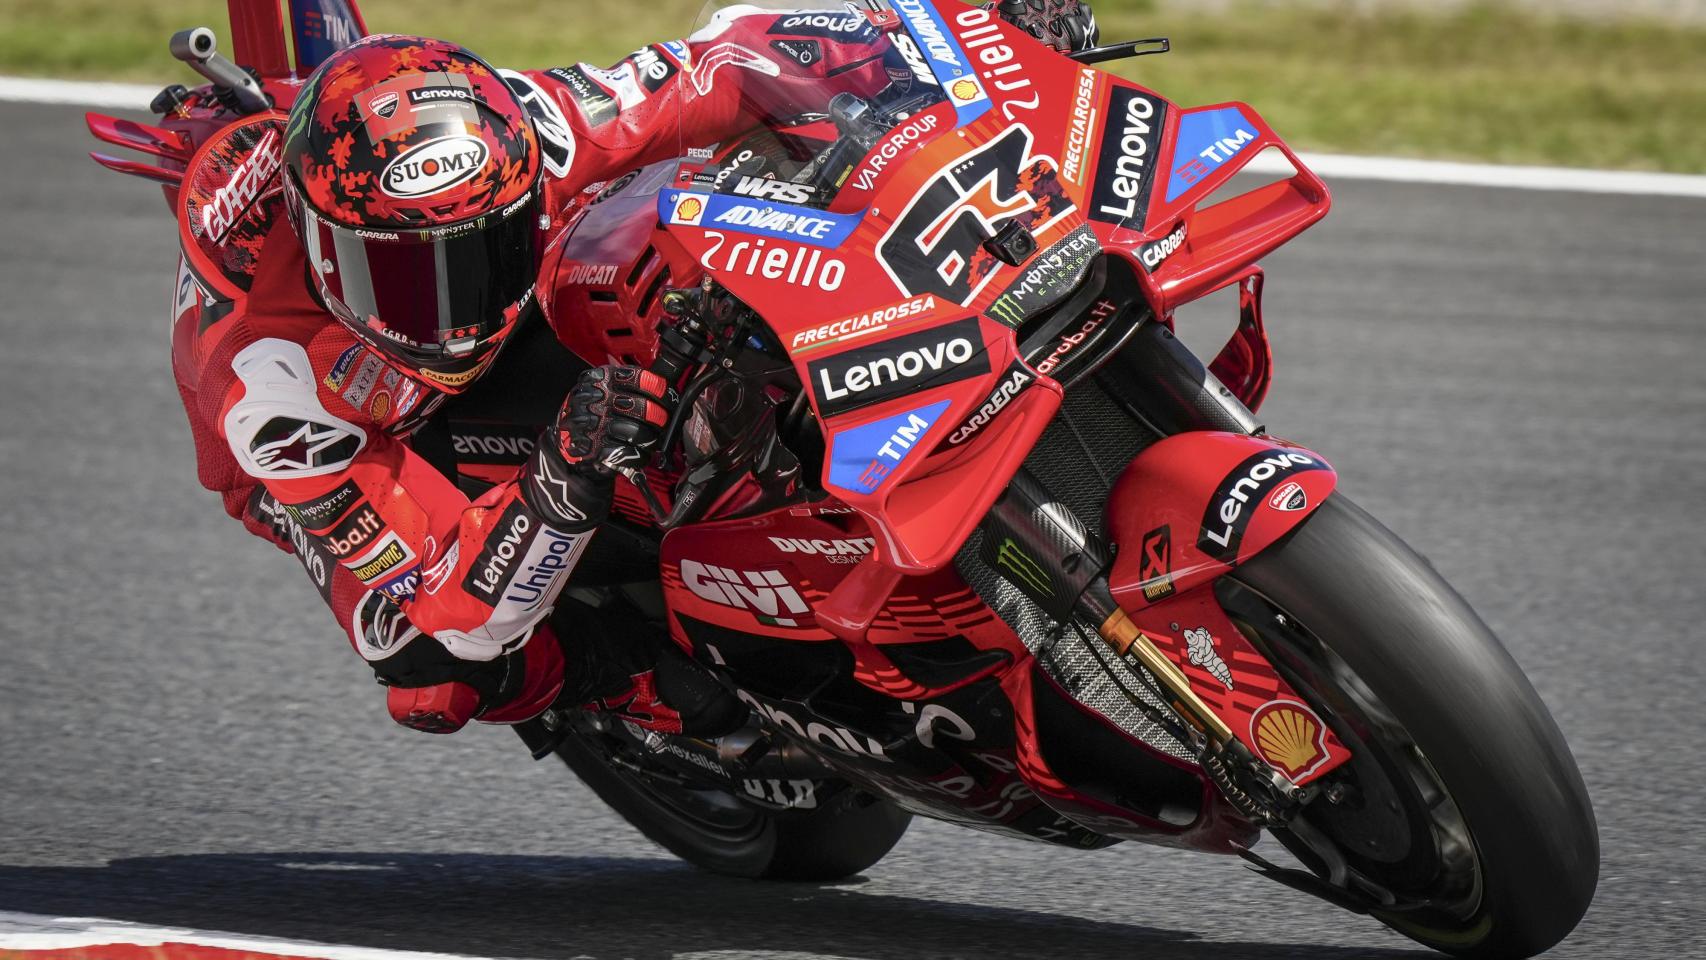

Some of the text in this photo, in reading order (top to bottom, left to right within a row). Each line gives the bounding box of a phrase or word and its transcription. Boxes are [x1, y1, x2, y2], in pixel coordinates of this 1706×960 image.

[323, 14, 349, 41] TIM
[783, 15, 873, 36] enovo
[888, 31, 938, 86] WRS
[411, 89, 467, 101] Lenovo
[1063, 68, 1096, 183] FRECCIAROSSA
[1200, 128, 1254, 163] TIM
[390, 150, 480, 184] SUOMY
[687, 147, 713, 159] PECCO
[713, 149, 753, 190] novo
[852, 113, 938, 191] VARGROUP
[1100, 96, 1154, 218] Lenovo
[733, 175, 816, 204] WRS
[355, 229, 400, 240] CARRERA
[714, 205, 836, 239] ADVANCE
[567, 265, 619, 285] DUCATI
[792, 296, 936, 348] FRECCIAROSSA
[1036, 299, 1117, 375] aruba.it
[350, 357, 381, 402] EATAL
[819, 337, 973, 401] Lenovo
[949, 370, 1029, 444] CARRERA
[877, 413, 929, 461] TIM
[300, 487, 352, 517] MONSTER
[1206, 453, 1314, 548] Lenovo
[472, 514, 530, 594] Lenovo
[506, 529, 576, 603] Unipol
[680, 558, 810, 617] GIVI
